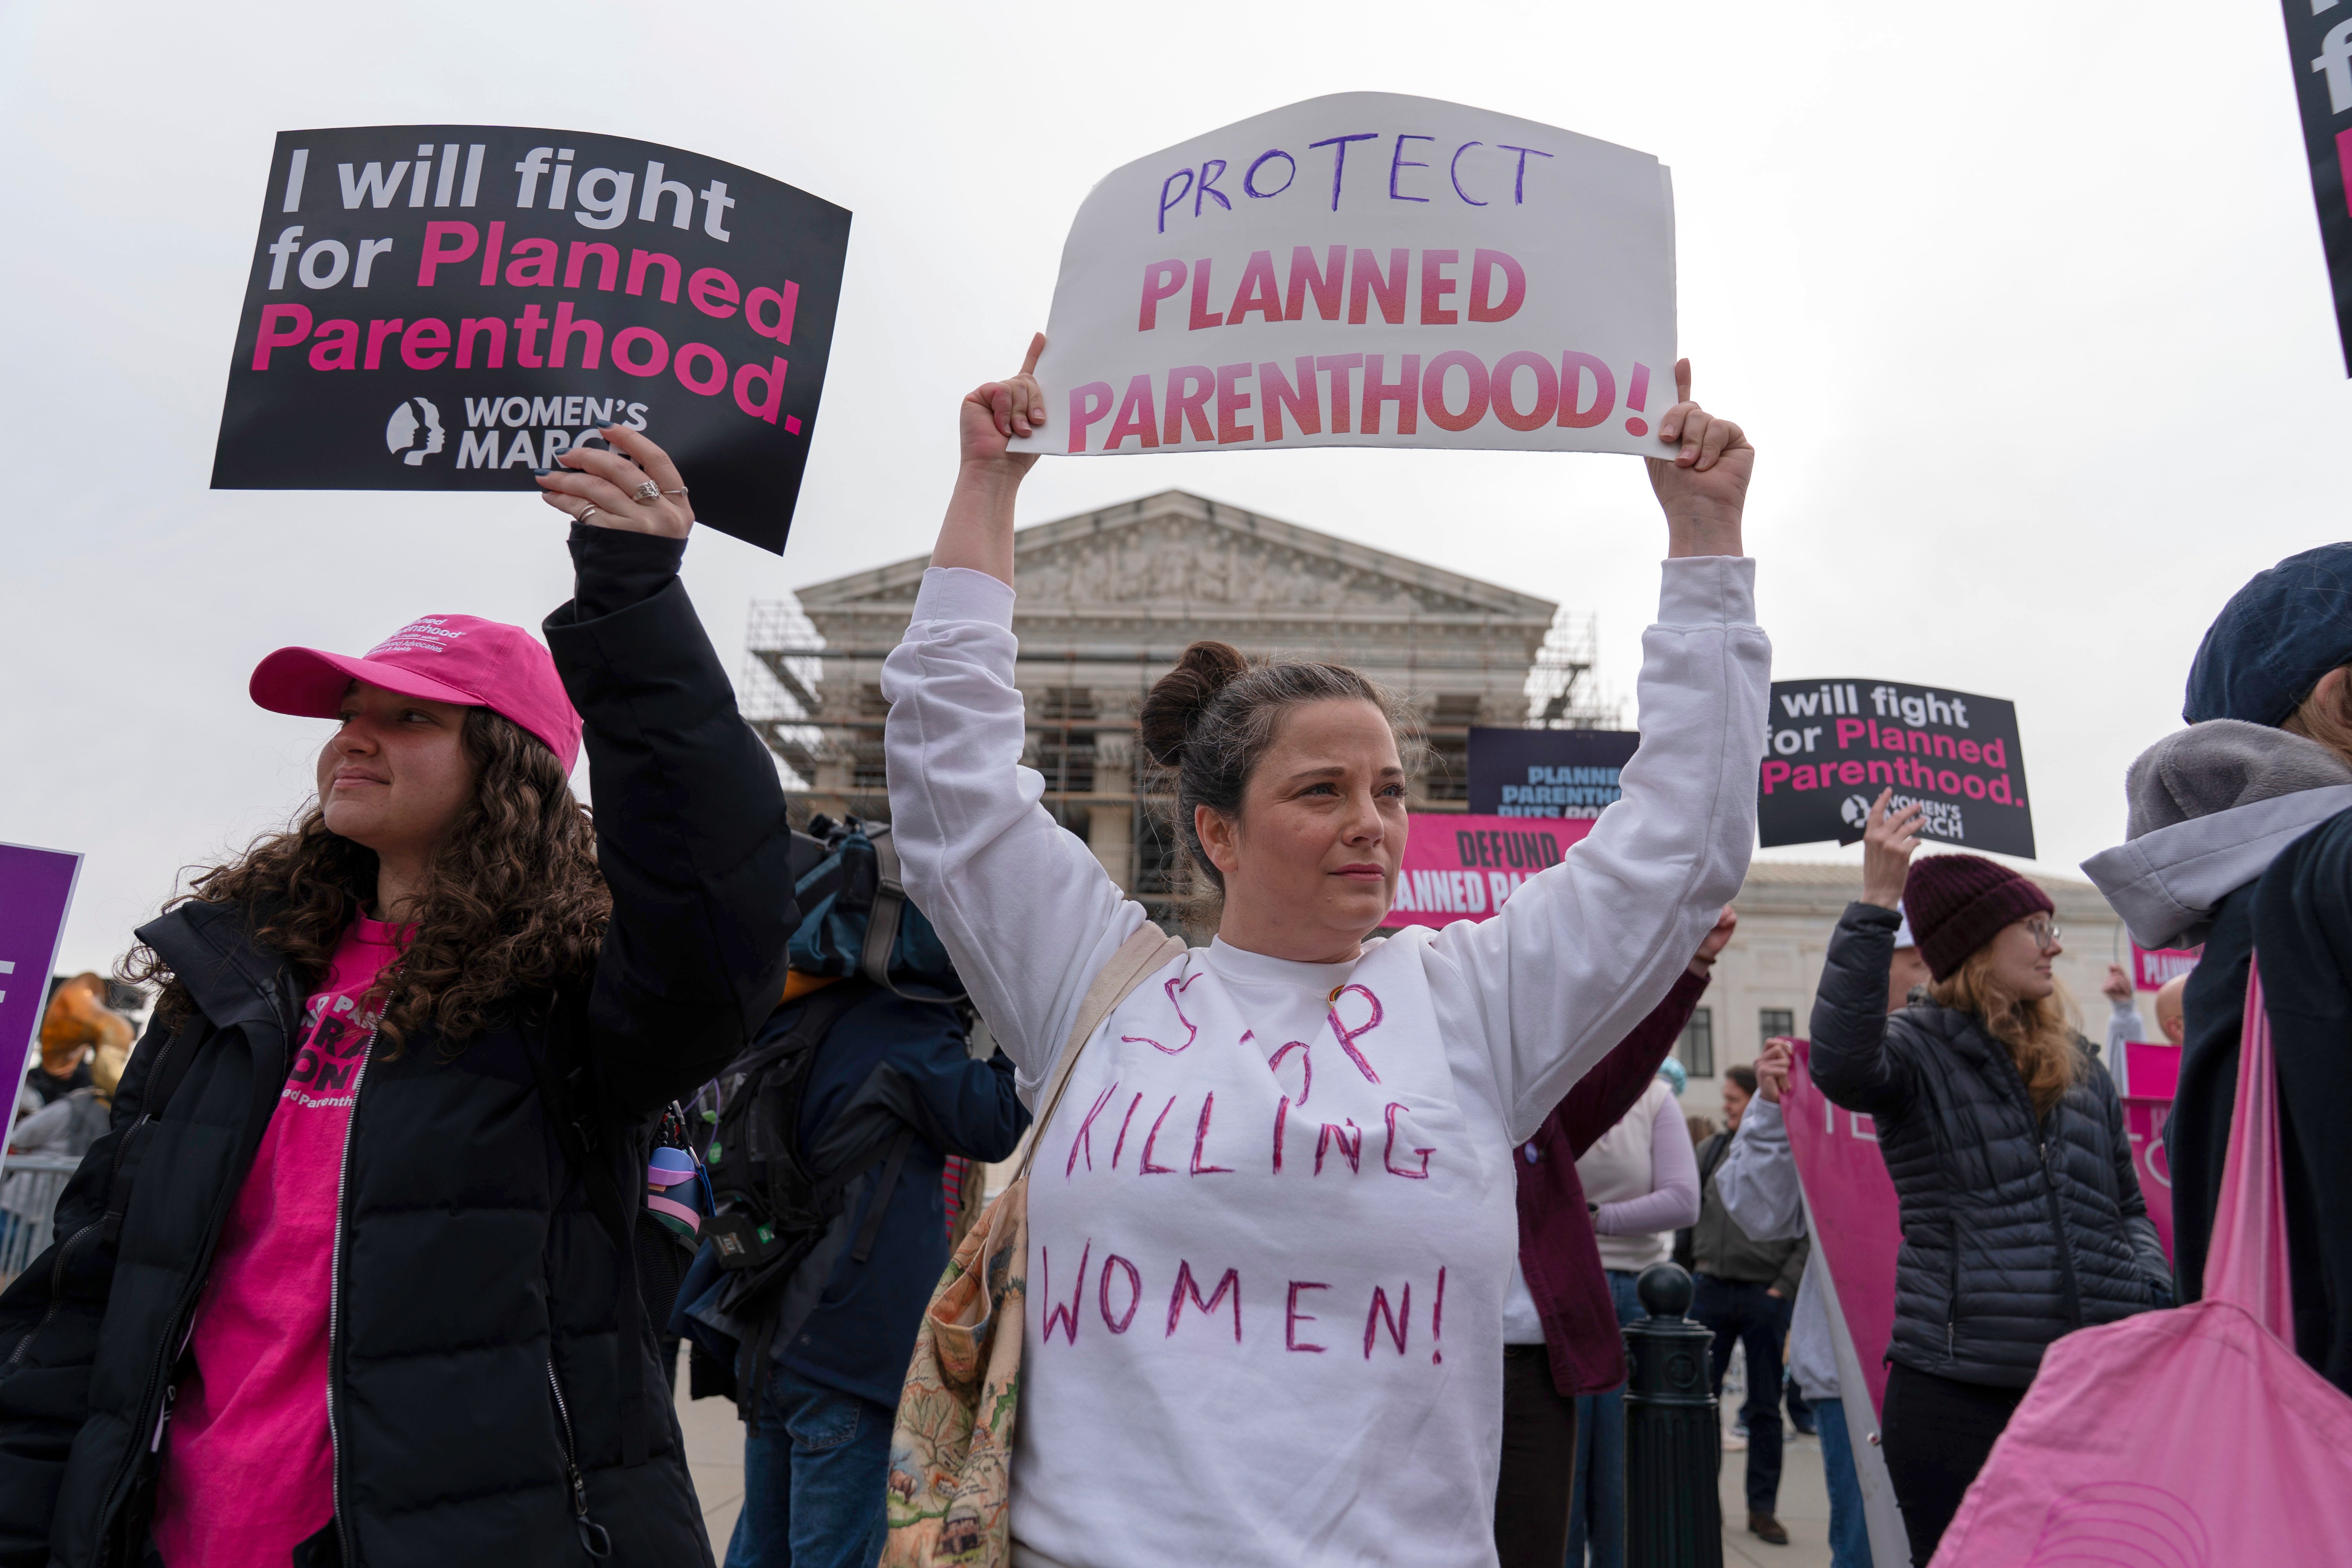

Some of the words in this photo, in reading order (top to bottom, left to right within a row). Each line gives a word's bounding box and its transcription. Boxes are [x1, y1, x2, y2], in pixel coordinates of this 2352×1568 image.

[283, 149, 309, 213] I
[338, 144, 486, 209] will
[515, 147, 735, 243] fight
[1157, 132, 1554, 234] PROTECT
[268, 225, 393, 290] for
[417, 221, 800, 346] Planned
[1138, 245, 1526, 332] PLANNED
[252, 301, 802, 436] Parenthood.
[464, 396, 649, 432] WOMEN'S
[1067, 350, 1650, 453] PARENTHOOD!
[1780, 684, 1859, 718] will
[1870, 686, 1969, 729] fight
[1836, 718, 2007, 769] Planned
[1761, 757, 2024, 808] Parenthood.
[1390, 869, 1487, 914] ANNED
[1455, 830, 1561, 868] DEFUND
[1066, 1081, 1436, 1181] KILLING
[1042, 1238, 1446, 1366] WOMEN!
